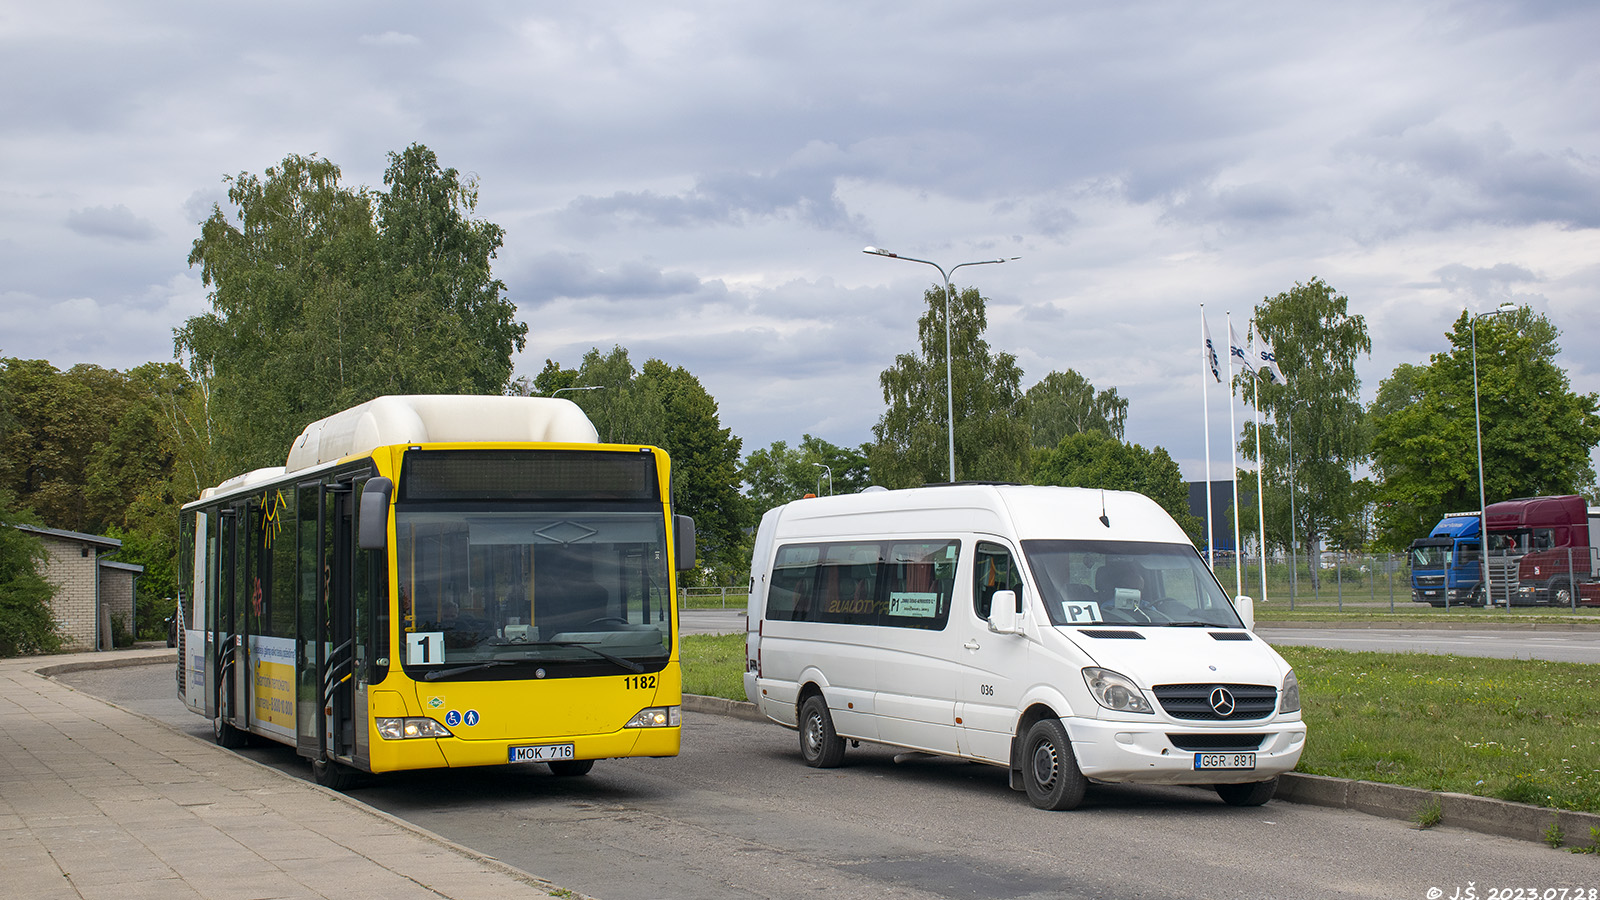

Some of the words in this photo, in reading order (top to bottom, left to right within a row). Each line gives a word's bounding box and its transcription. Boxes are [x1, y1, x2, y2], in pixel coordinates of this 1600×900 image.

[891, 598, 900, 612] P1
[1067, 604, 1097, 621] P1
[417, 636, 430, 663] 1
[624, 675, 656, 690] 1182
[980, 684, 994, 696] 036
[517, 747, 543, 760] MOK
[550, 746, 572, 758] 716
[1202, 755, 1227, 767] GGR
[1233, 754, 1252, 767] 891
